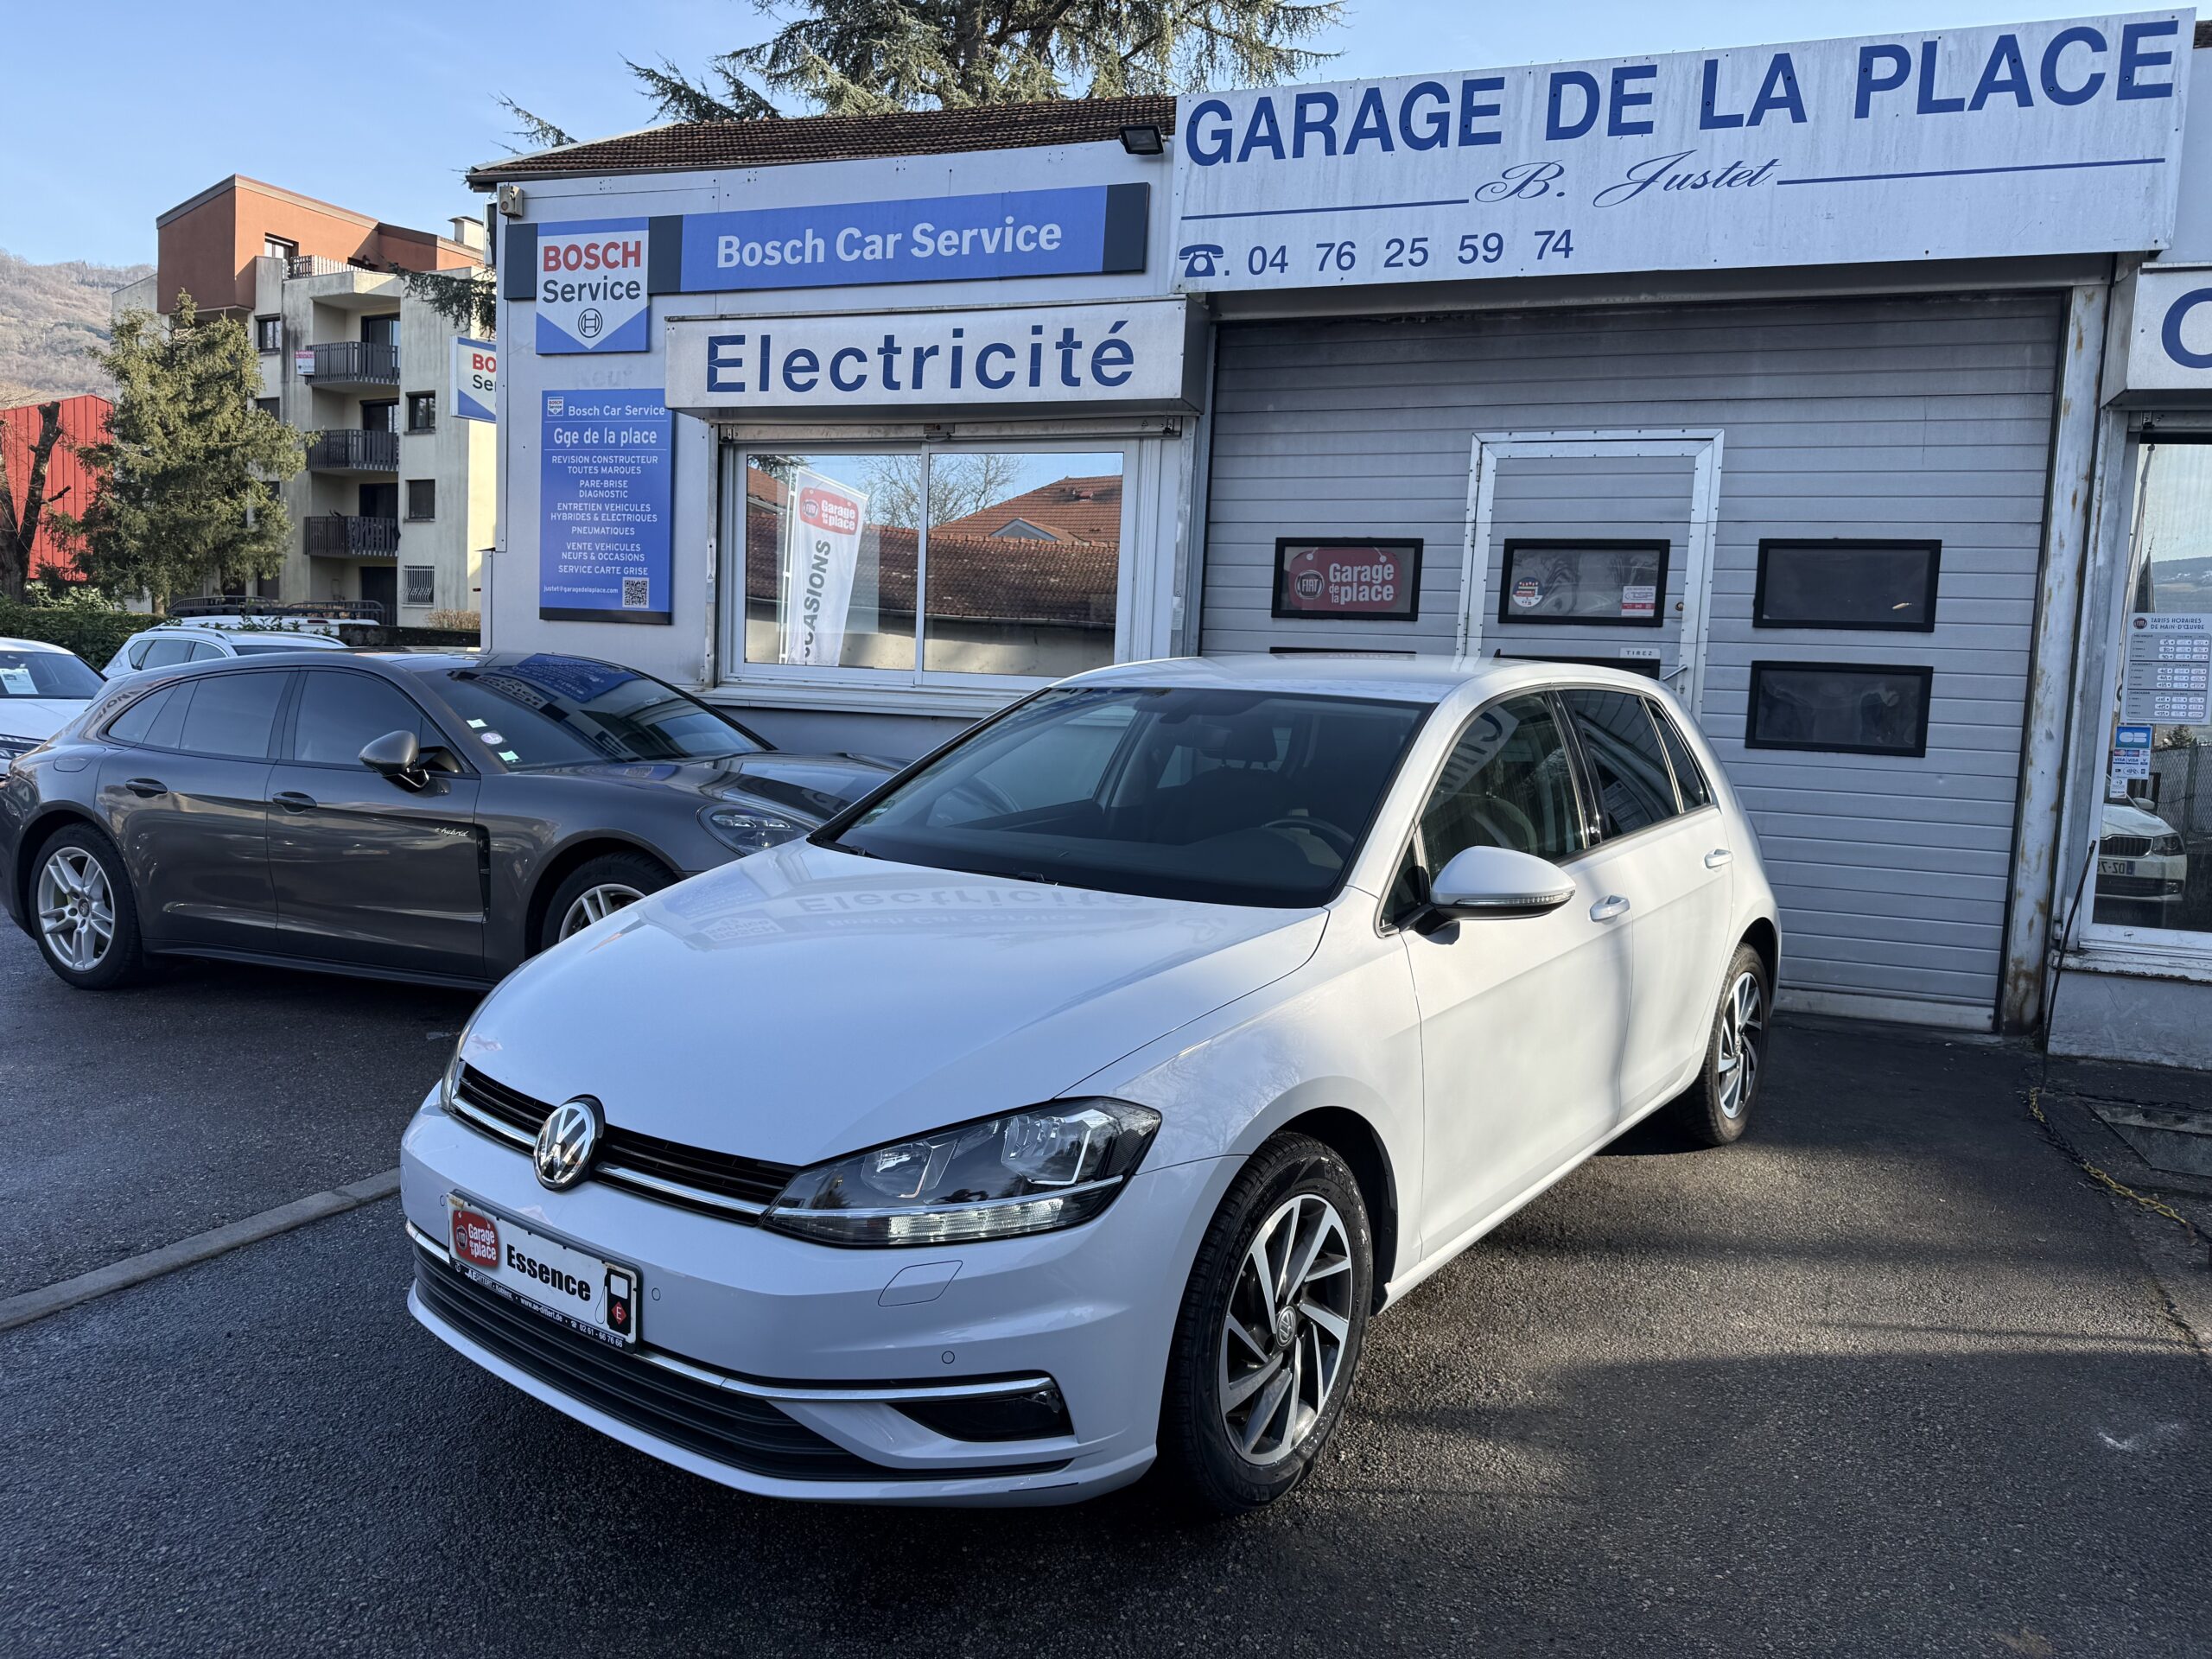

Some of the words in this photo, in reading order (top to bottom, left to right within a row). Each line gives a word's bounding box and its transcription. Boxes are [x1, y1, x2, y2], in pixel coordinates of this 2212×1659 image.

[1185, 77, 1505, 167] GARAGE
[1545, 64, 1658, 141] DE
[1699, 53, 1808, 130] LA
[1853, 20, 2179, 119] PLACE
[1474, 159, 1566, 203] B.
[1592, 149, 1783, 208] Justet
[716, 228, 825, 269] Bosch
[836, 226, 903, 261] Car
[910, 215, 1063, 258] Service
[543, 240, 642, 272] BOSCH
[1248, 245, 1289, 276] 04
[1316, 240, 1357, 271] 76
[1383, 237, 1430, 267] 25
[1458, 232, 1503, 264] 59
[1534, 228, 1574, 260] 74
[542, 275, 641, 304] Service
[706, 320, 1135, 392] Electricité
[568, 405, 600, 416] Bosch
[603, 404, 622, 416] Car
[625, 404, 665, 416] Service
[553, 428, 579, 448] Gge
[583, 427, 600, 444] de
[604, 427, 616, 444] la
[620, 427, 658, 448] place
[551, 455, 589, 464] REVISION
[592, 455, 658, 464] CONSTRUCTEUR
[568, 466, 598, 474] TOUTES
[601, 466, 642, 474] MARQUES
[579, 480, 628, 488] PARE-BRISE
[556, 502, 602, 512] ENTRETIEN
[605, 503, 651, 512] VEHICULES
[550, 512, 591, 521] HYBRIDES
[601, 513, 658, 522] ELECTRIQUES
[571, 526, 635, 535] PNEUMATIQUES
[566, 542, 592, 550] VENTE
[594, 543, 641, 551] VEHICULES
[590, 552, 596, 561] &
[597, 553, 645, 562] OCCASIONS
[558, 565, 592, 574] SERVICE
[594, 566, 621, 575] CARTE
[623, 567, 648, 575] GRISE
[1328, 563, 1395, 584] Garage
[1301, 578, 1319, 593] FIAT
[1329, 583, 1339, 594] de
[1332, 594, 1339, 603] la
[1339, 582, 1395, 605] place
[435, 826, 469, 837] e-hybrid
[467, 1223, 495, 1245] Garage
[474, 1242, 497, 1261] place
[506, 1243, 591, 1302] Essence
[615, 1306, 622, 1320] E
[579, 1324, 587, 1332] 02
[607, 1336, 614, 1344] 76
